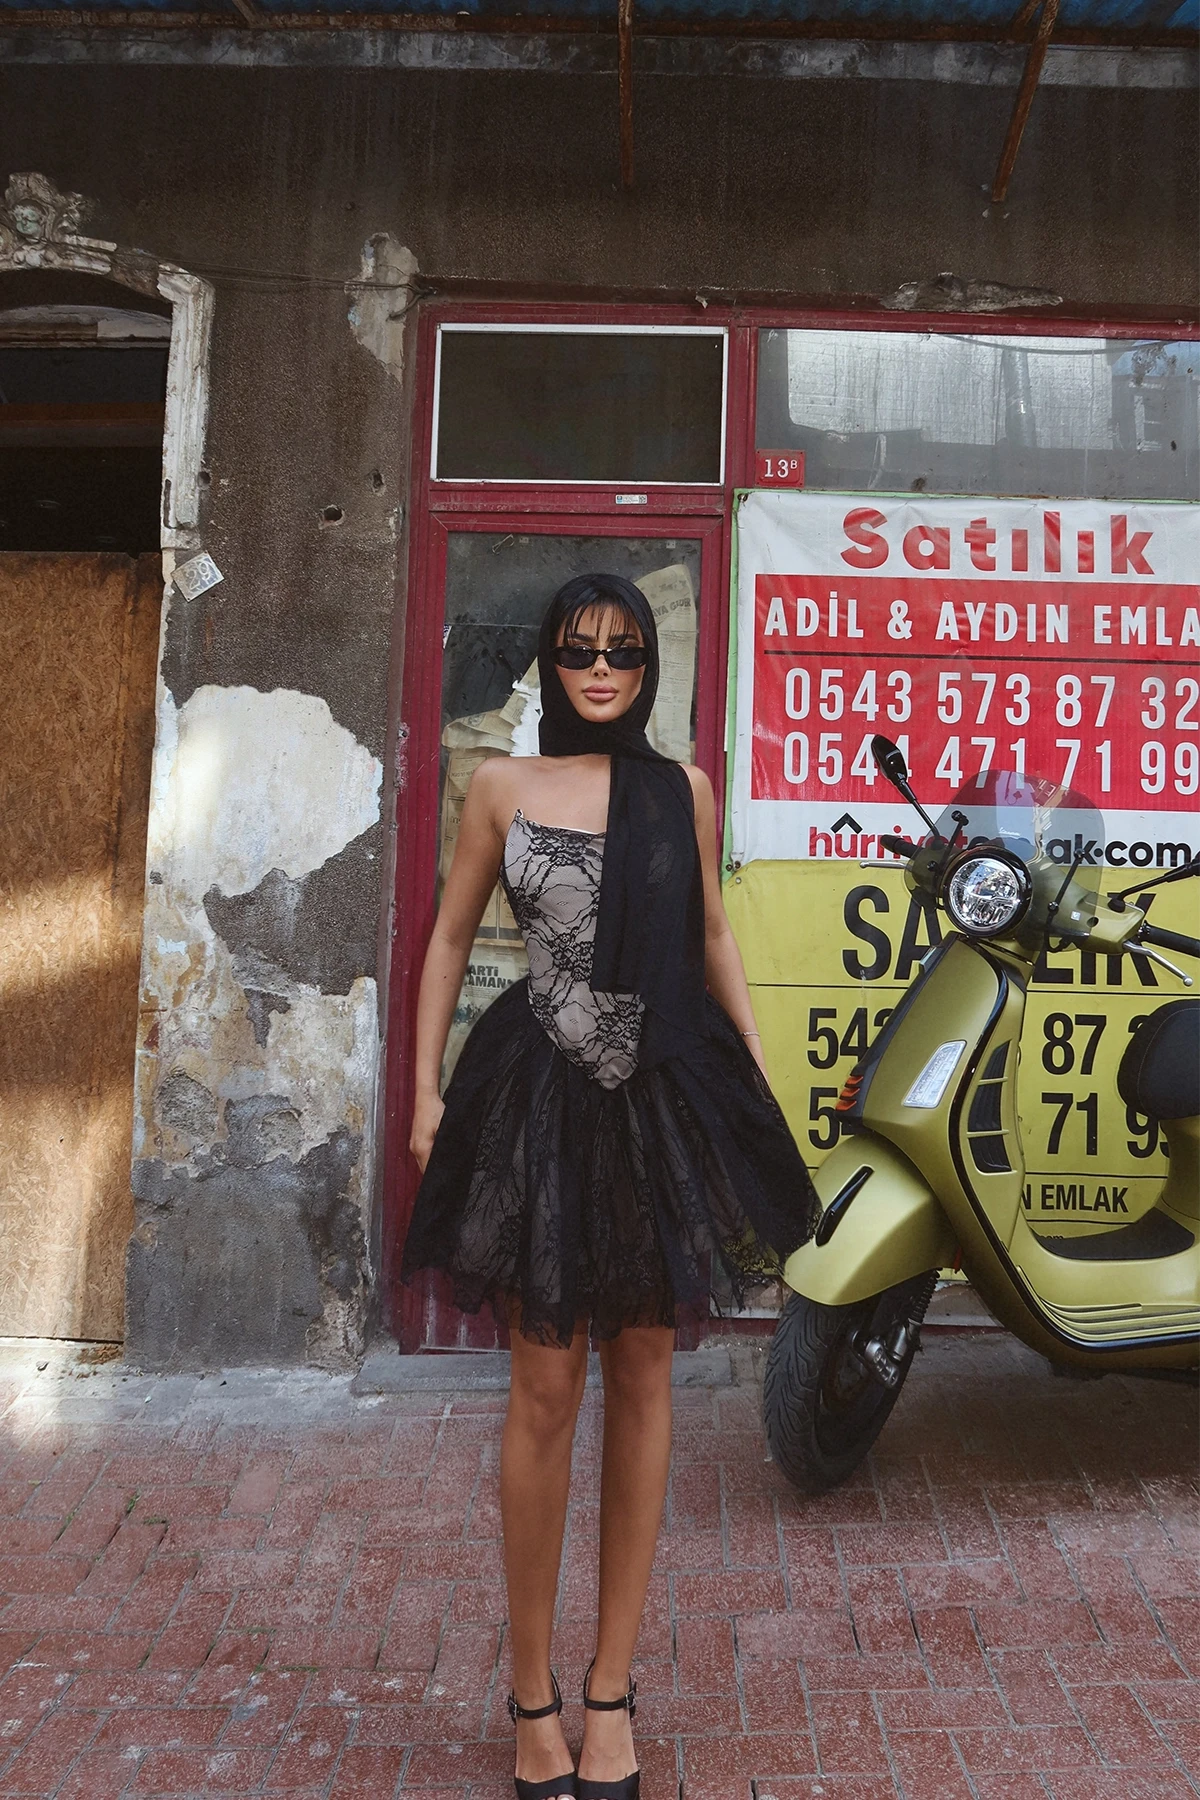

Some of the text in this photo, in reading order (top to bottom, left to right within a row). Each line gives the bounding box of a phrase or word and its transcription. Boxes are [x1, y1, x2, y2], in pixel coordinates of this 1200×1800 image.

[840, 507, 1155, 575] Satılık
[764, 591, 864, 638] ADİL
[887, 599, 913, 640] &
[935, 602, 1069, 643] AYDIN
[785, 667, 1199, 730] 0543 573 87 32
[935, 736, 1026, 790] 471
[1055, 739, 1111, 792] 71
[1140, 742, 1200, 794] 99
[1041, 1013, 1107, 1075] 87
[1041, 1092, 1098, 1156] 71
[1041, 1185, 1129, 1213] EMLAK
